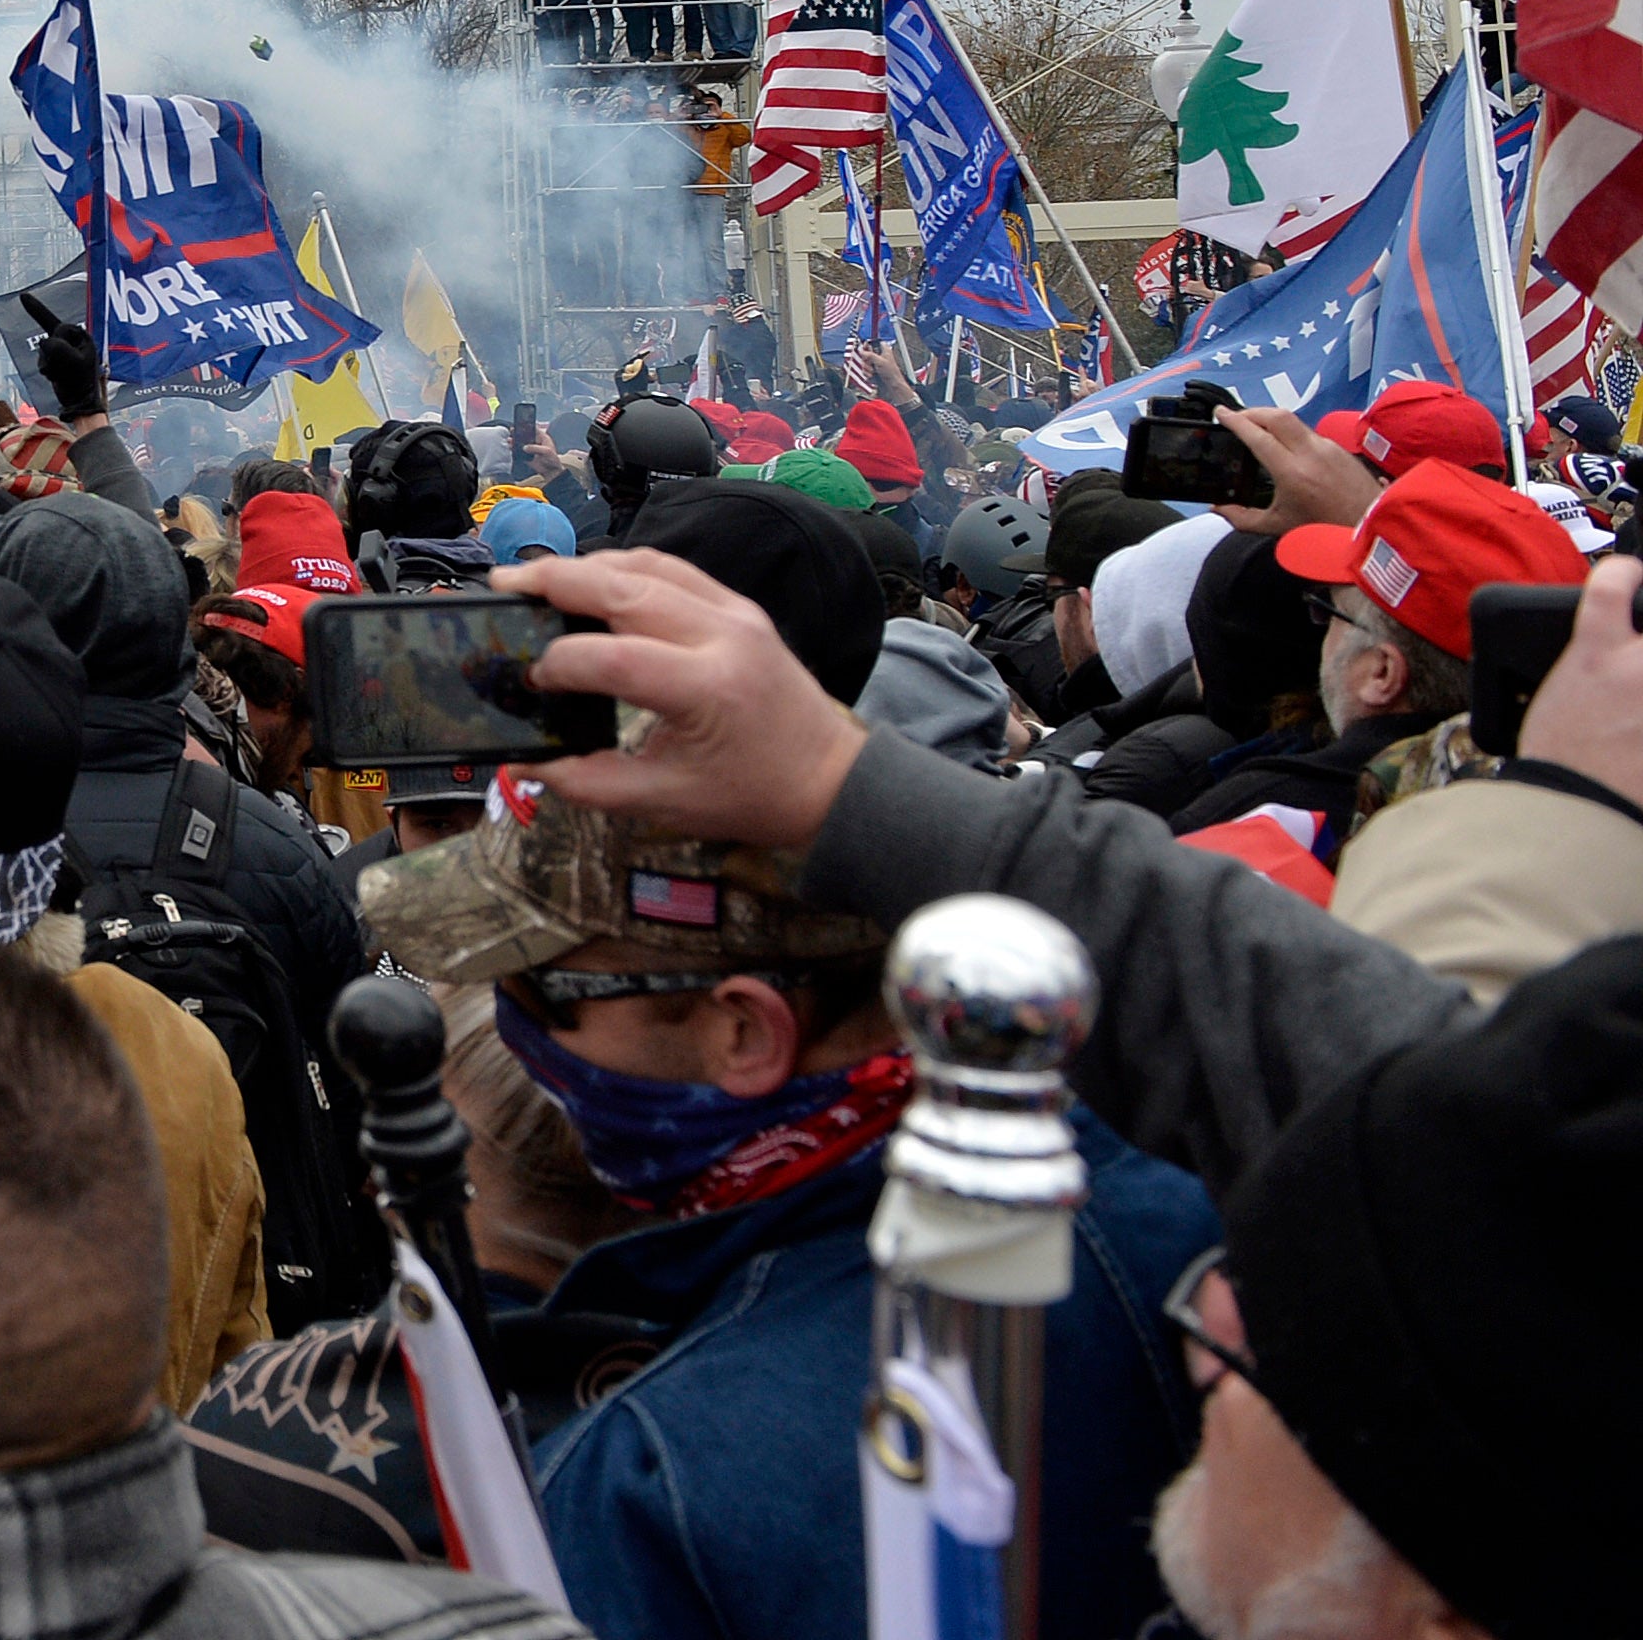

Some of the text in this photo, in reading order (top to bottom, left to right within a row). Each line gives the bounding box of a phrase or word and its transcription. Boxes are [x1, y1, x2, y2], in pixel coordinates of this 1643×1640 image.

[917, 182, 967, 249] ERICA
[291, 556, 353, 583] Trump
[308, 576, 348, 592] 2020
